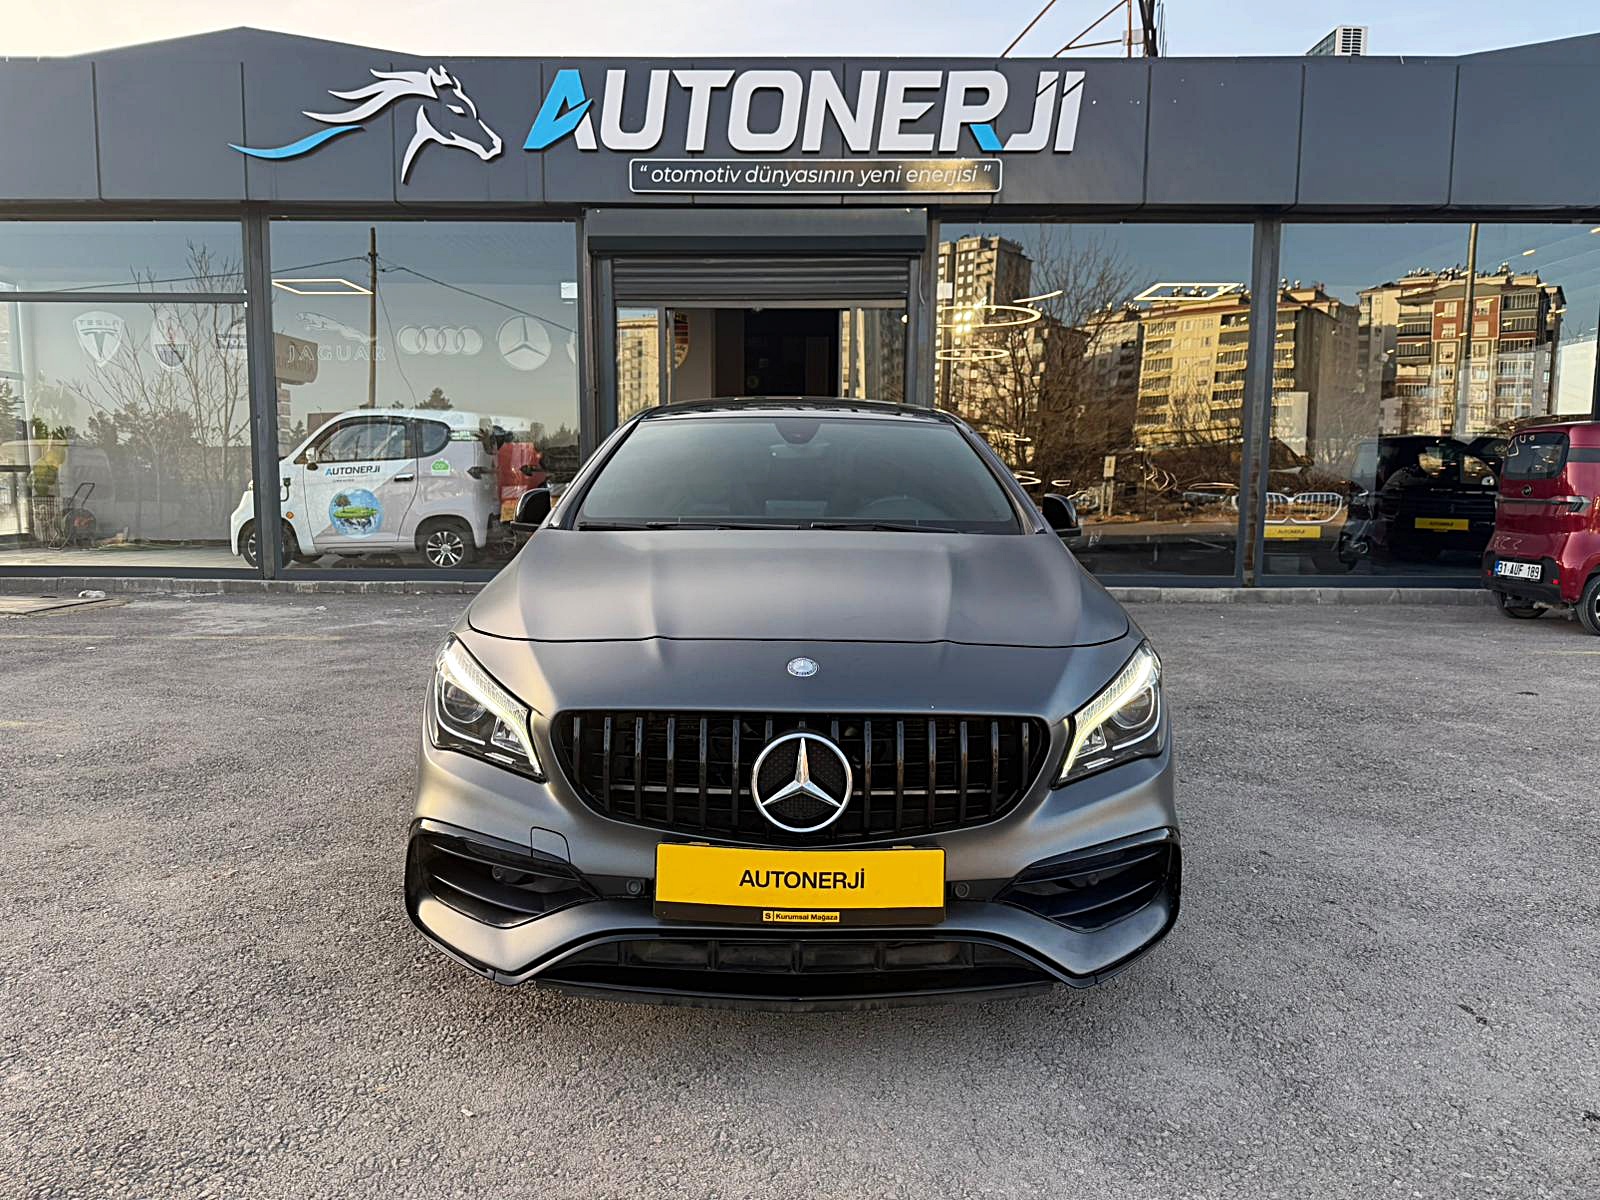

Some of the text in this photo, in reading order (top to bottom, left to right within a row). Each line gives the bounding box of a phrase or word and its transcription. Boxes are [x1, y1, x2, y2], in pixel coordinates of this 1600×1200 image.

[651, 165, 741, 184] otomotiv
[745, 165, 853, 187] dünyasının
[857, 166, 902, 186] yeni
[906, 166, 978, 186] enerjisi
[287, 344, 386, 362] JAGUAR
[775, 912, 809, 921] Kurumsal
[811, 912, 839, 922] Mağaza
